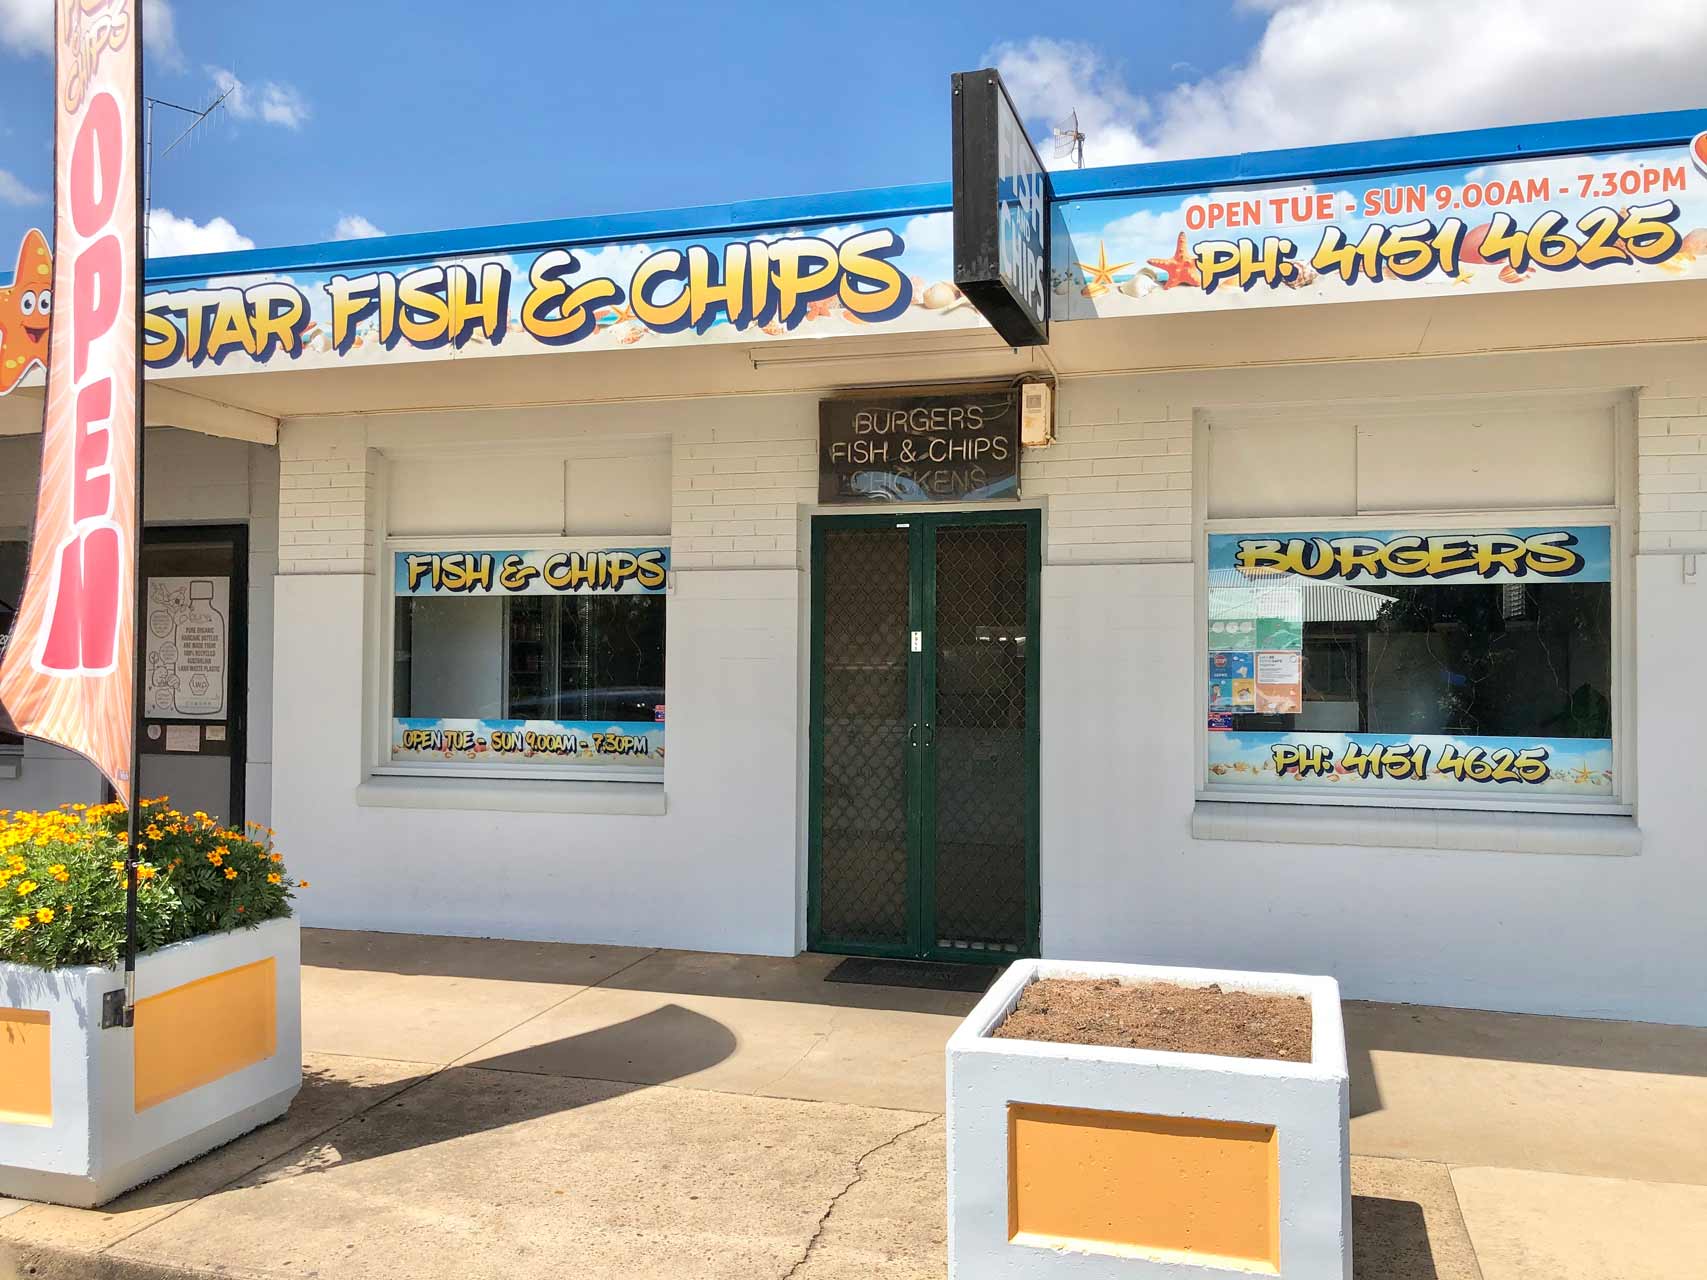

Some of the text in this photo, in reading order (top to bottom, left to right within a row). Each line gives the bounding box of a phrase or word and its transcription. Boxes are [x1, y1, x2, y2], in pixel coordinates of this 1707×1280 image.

[64, 12, 129, 115] CHIPS
[1016, 204, 1031, 242] AND
[1185, 200, 1266, 231] OPEN
[1269, 194, 1335, 226] TUE
[1364, 185, 1428, 218] SUN
[1434, 176, 1552, 213] 9.00AM
[1578, 166, 1688, 200] 7.30PM
[1001, 199, 1045, 322] CHIPS
[1193, 198, 1682, 294] PH: 4151 4625
[144, 227, 913, 368] STAR FISH & CHIPS
[41, 91, 123, 670] OPEN
[855, 405, 984, 434] BURGERS
[831, 436, 1009, 465] FISH & CHIPS
[405, 549, 666, 593] FISH & CHIPS
[1235, 531, 1585, 582] BURGERS
[403, 728, 443, 750] OPEN
[443, 730, 475, 751] TUE
[490, 731, 526, 752] SUN
[524, 731, 578, 753] 9.00AM
[591, 733, 649, 755] 7.30PM
[1272, 744, 1550, 784] PH: 4151 4625
